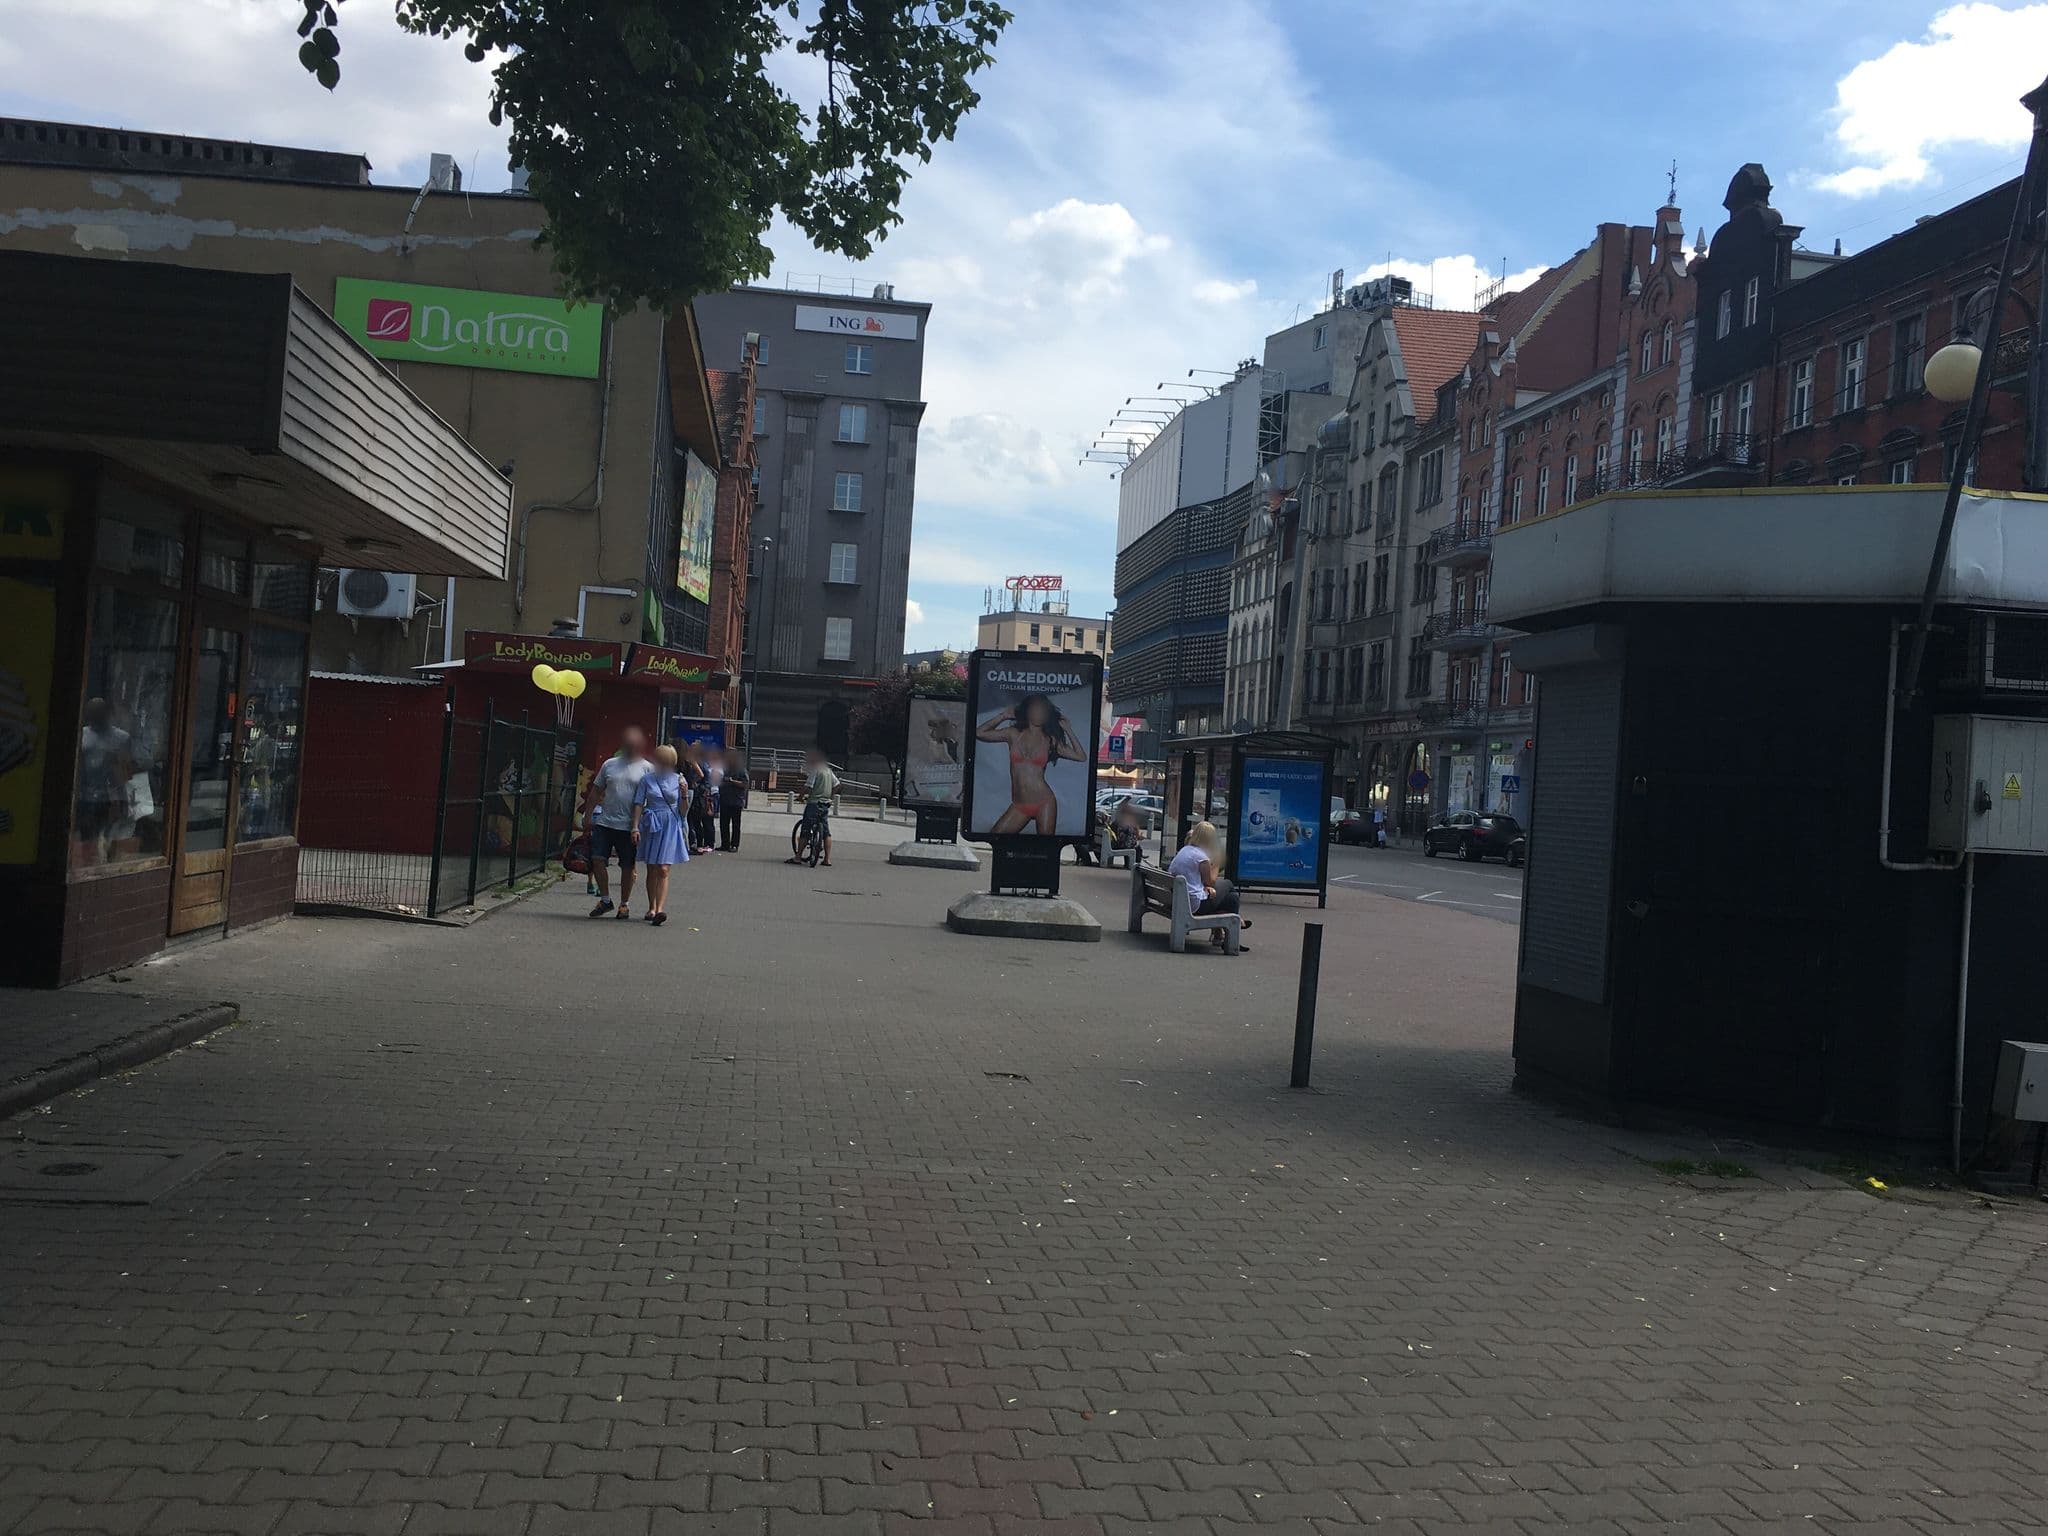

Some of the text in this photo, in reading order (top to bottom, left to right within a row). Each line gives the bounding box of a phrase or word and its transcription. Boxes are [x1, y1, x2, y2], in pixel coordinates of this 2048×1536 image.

[829, 316, 860, 330] ING
[987, 670, 1082, 685] CALZEDONIA
[1027, 685, 1069, 693] BEACHWEAR
[1112, 737, 1123, 751] P
